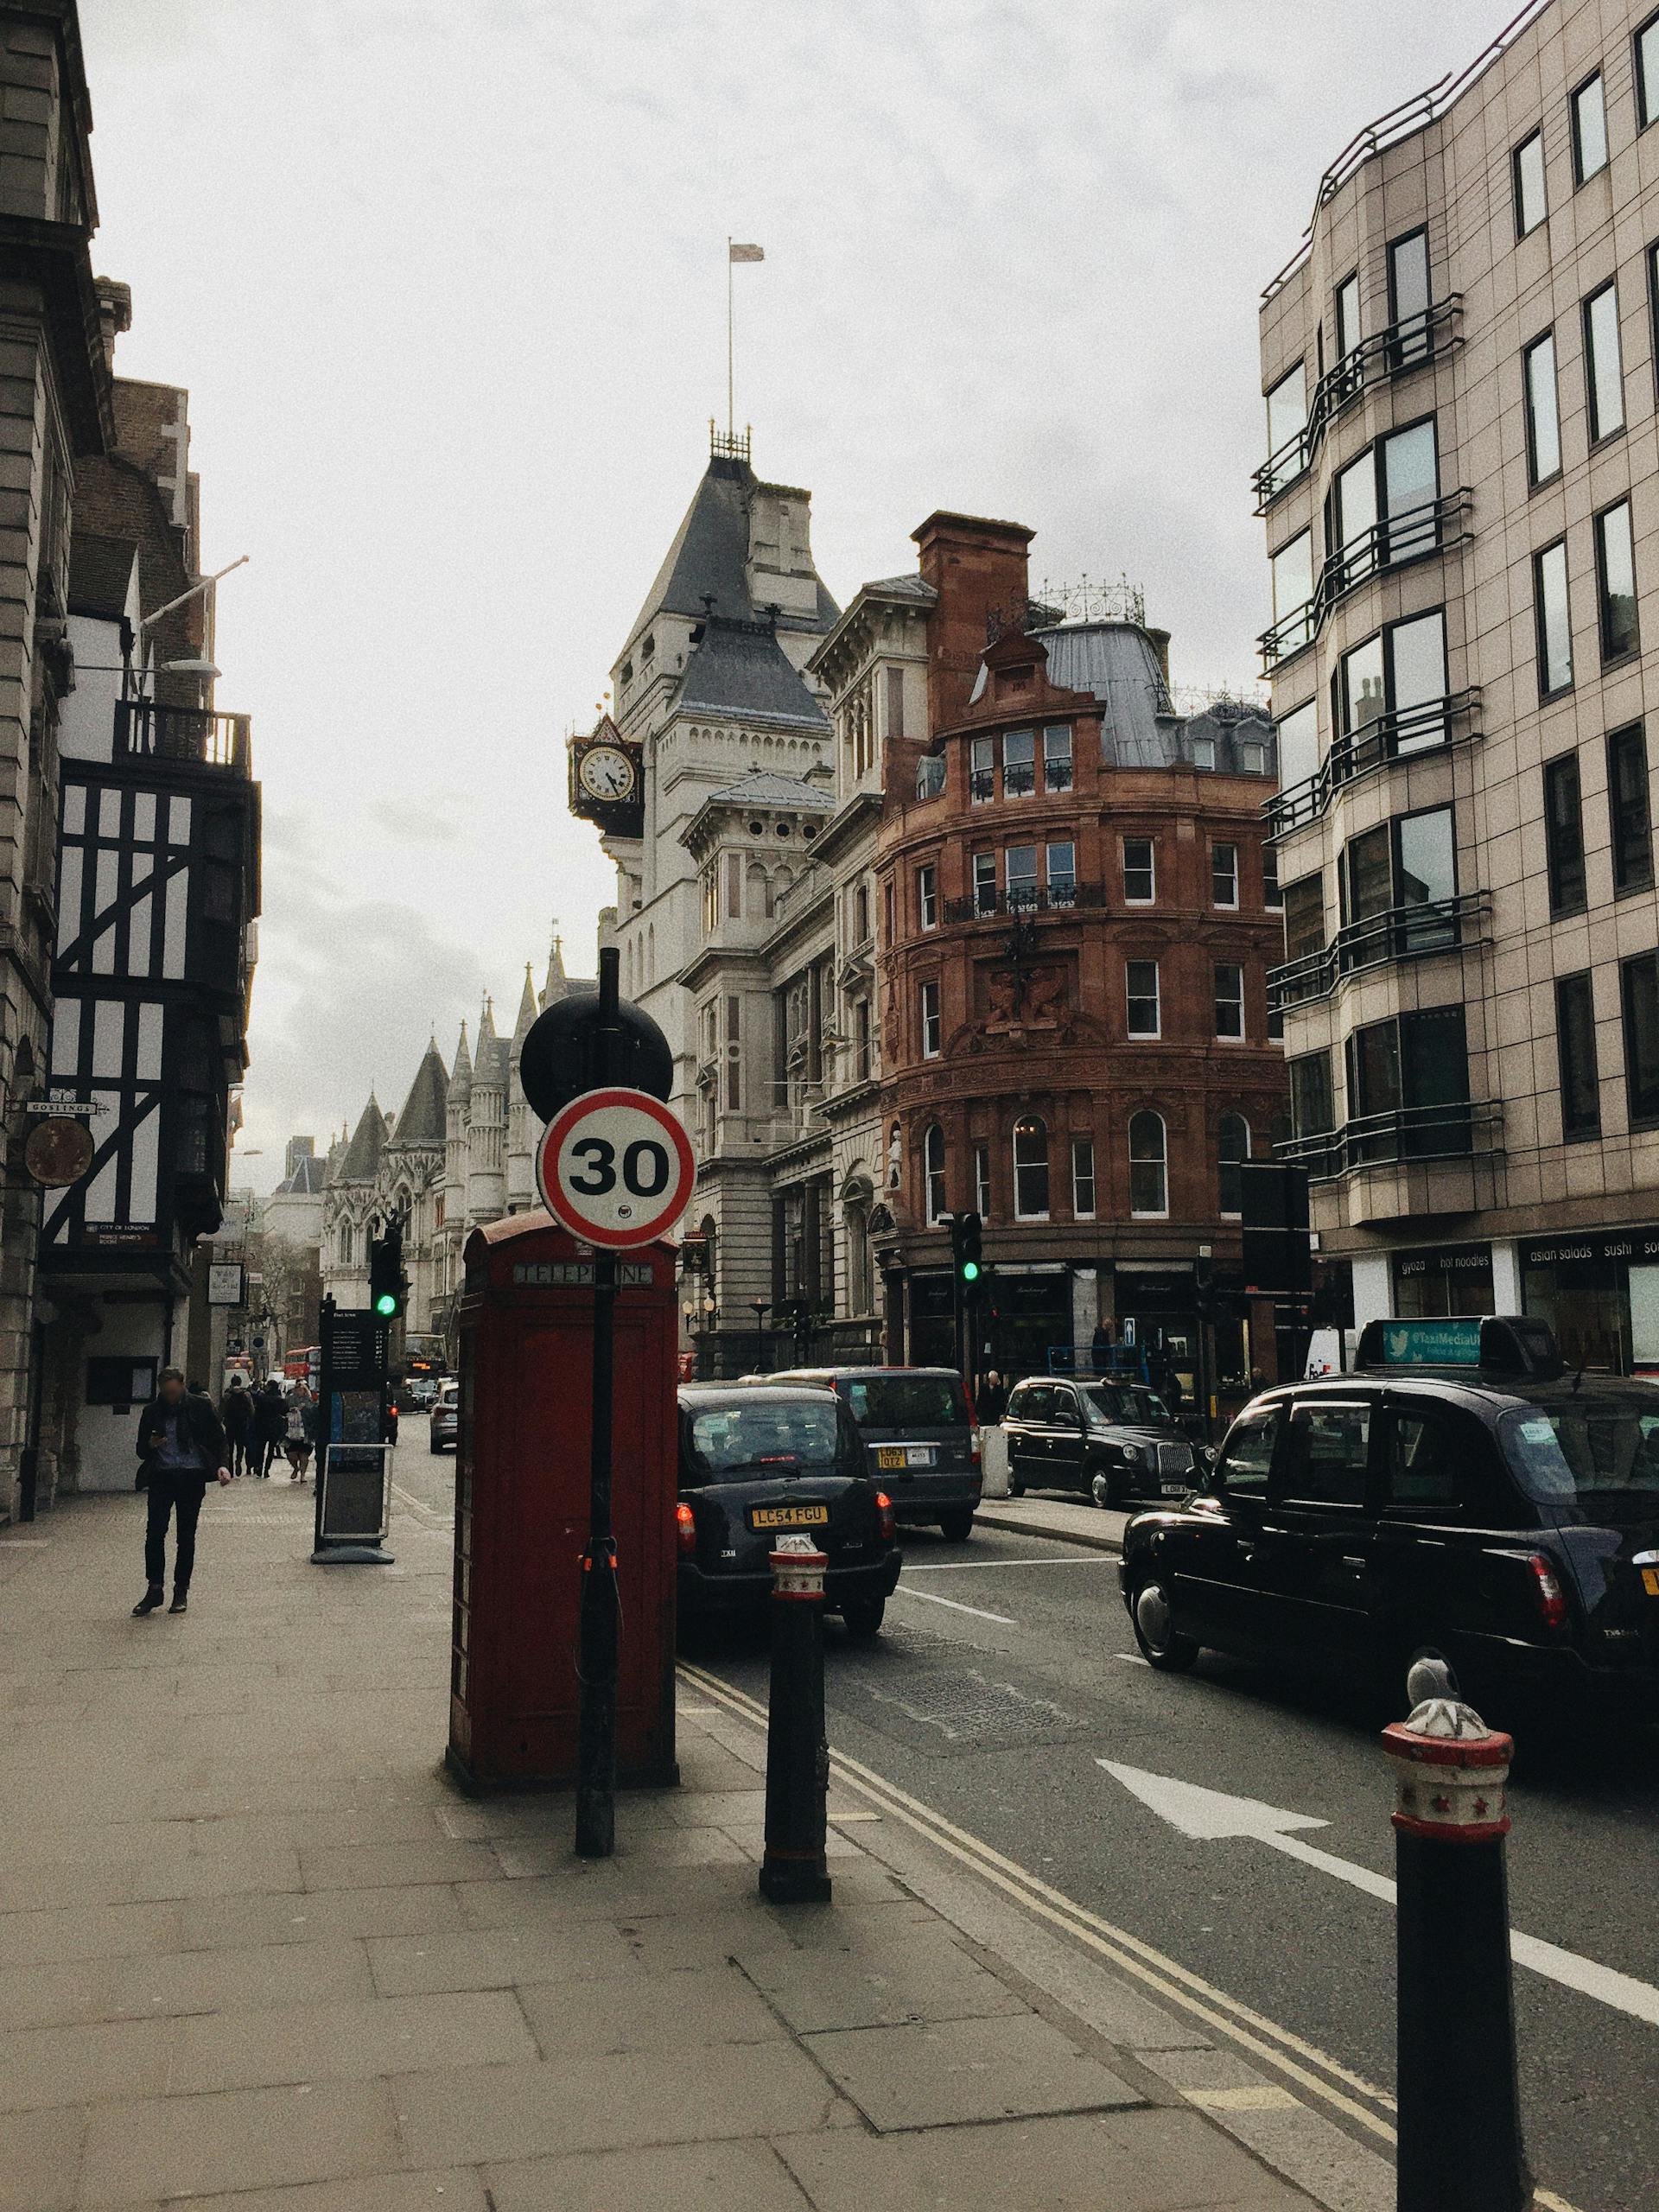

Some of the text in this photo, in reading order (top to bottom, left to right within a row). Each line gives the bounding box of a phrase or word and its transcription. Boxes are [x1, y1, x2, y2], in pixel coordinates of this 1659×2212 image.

[569, 1138, 669, 1197] 30
[1530, 1242, 1659, 1262] asian salads sushi so
[522, 1264, 650, 1282] TELEPNE
[1402, 1253, 1488, 1274] gyoza hot noodles
[758, 1508, 821, 1523] LC54 FGU
